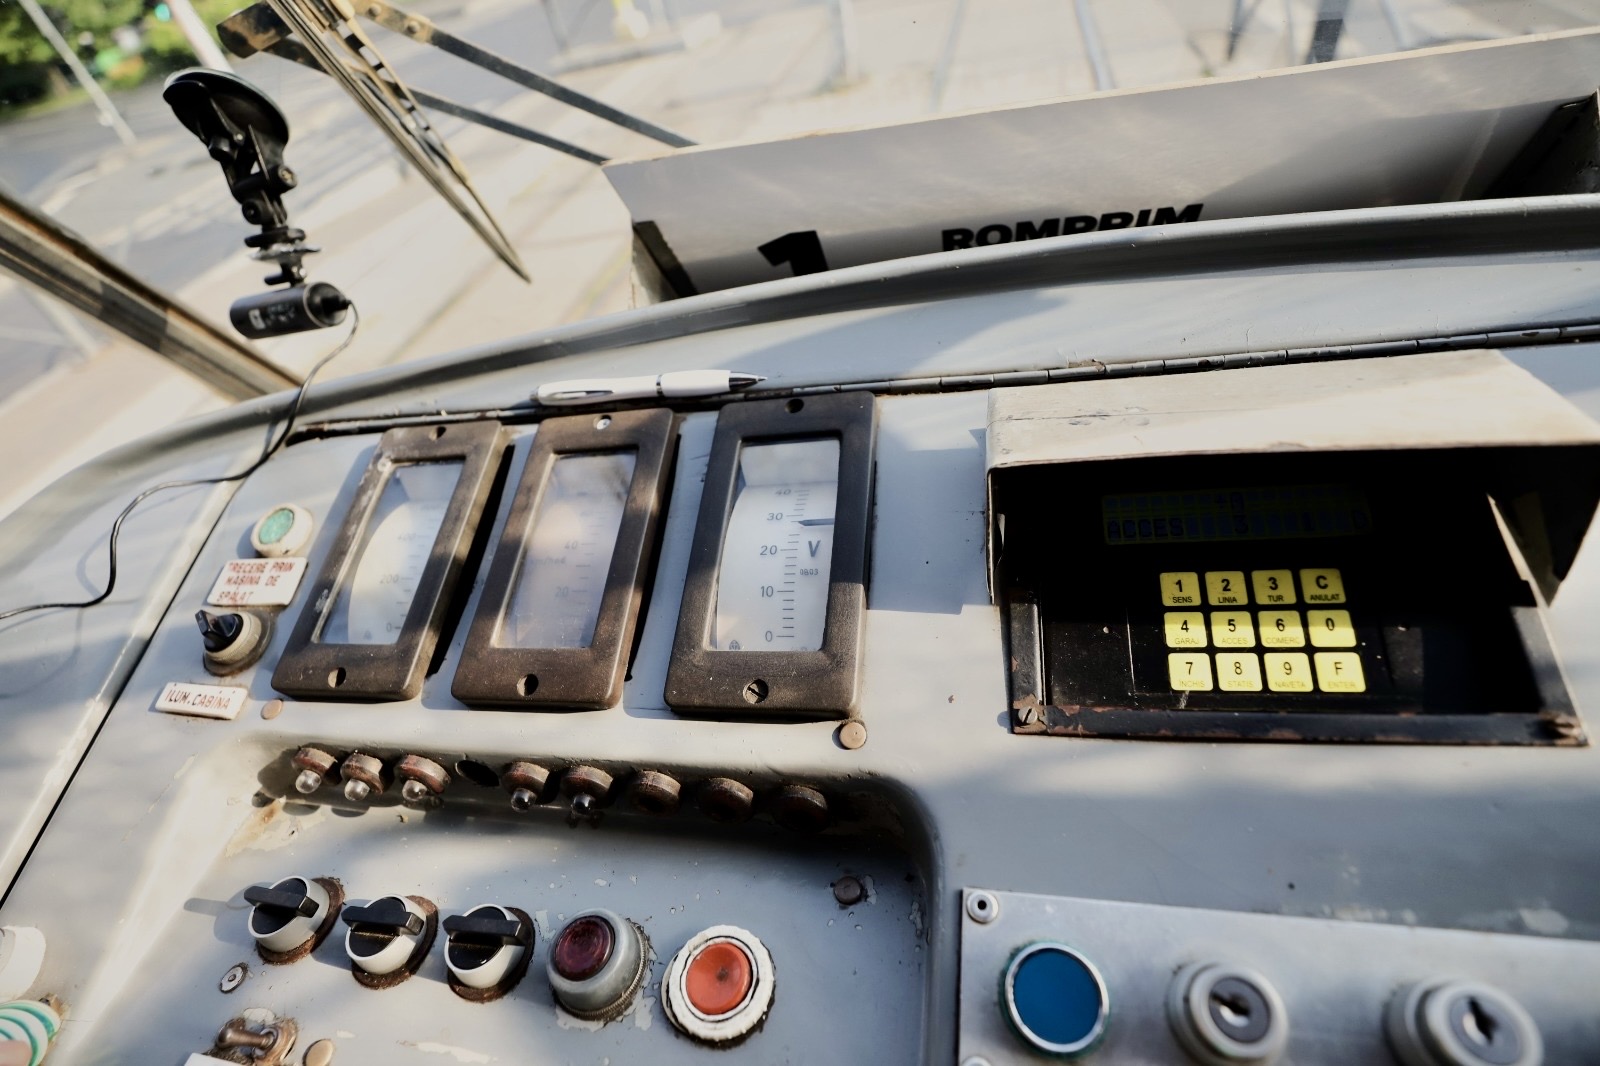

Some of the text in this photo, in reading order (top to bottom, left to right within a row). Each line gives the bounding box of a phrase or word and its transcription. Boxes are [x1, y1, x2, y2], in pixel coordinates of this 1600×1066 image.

[942, 203, 1204, 252] ROMPRIM
[767, 512, 783, 521] 30
[760, 544, 777, 556] 20
[808, 540, 821, 557] V
[265, 575, 281, 587] DE
[1175, 579, 1183, 593] 1
[1221, 578, 1231, 592] 2
[1268, 577, 1278, 591] 3
[1315, 575, 1328, 589] C
[760, 585, 774, 598] 10
[1267, 594, 1284, 602] TUR
[1172, 596, 1192, 604] SENS
[1218, 596, 1237, 604] LINIA
[1180, 620, 1189, 633] 4
[1228, 619, 1236, 632] 5
[1276, 618, 1285, 631] 6
[1325, 618, 1335, 631] 0
[765, 630, 773, 642] 0
[1174, 637, 1200, 645] GARAJ
[1221, 637, 1248, 645] ACCES
[1185, 662, 1193, 675] 7
[1234, 661, 1242, 675] 8
[1283, 661, 1292, 675] 9
[1334, 661, 1342, 675] F
